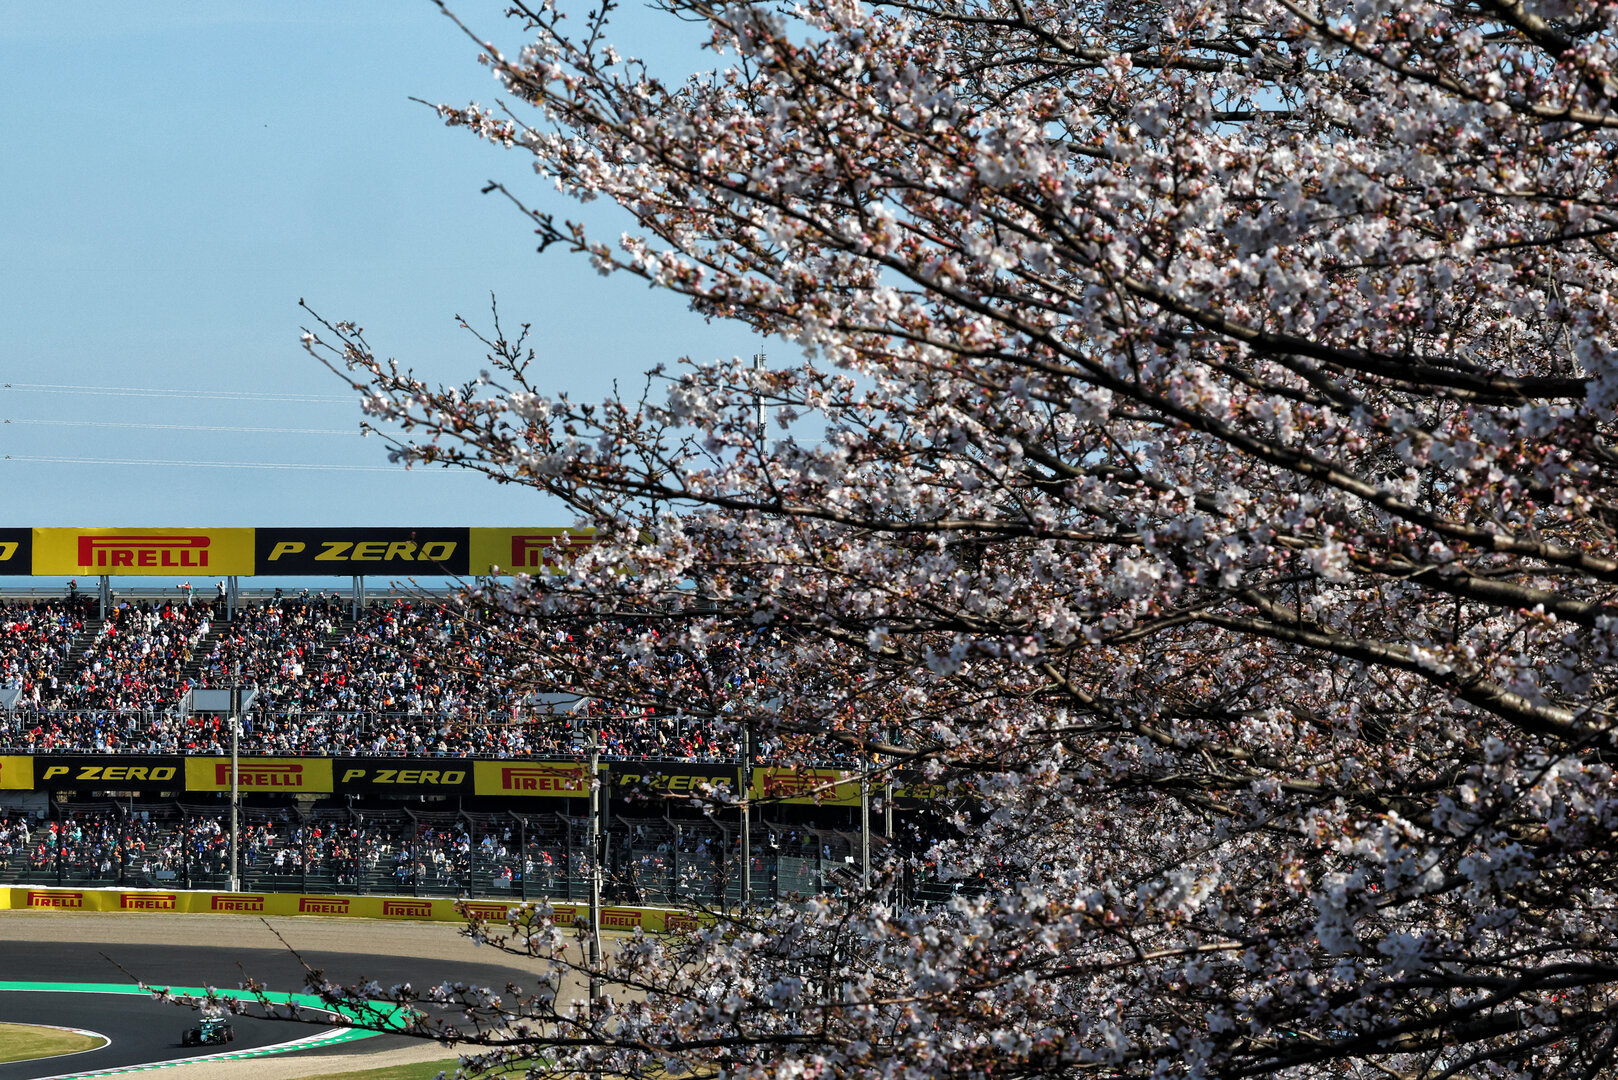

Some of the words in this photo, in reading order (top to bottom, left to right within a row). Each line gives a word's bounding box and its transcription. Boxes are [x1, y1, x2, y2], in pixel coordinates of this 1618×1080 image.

[77, 535, 211, 567] PIRELLI
[267, 541, 306, 561] P
[314, 541, 458, 561] ZERO
[42, 765, 70, 780] P
[75, 766, 177, 781] ZERO
[341, 769, 366, 783] P
[372, 769, 466, 785] ZERO
[27, 891, 83, 908] PIRELLI
[120, 894, 177, 910] PIRELLI
[211, 895, 265, 911] PIRELLI
[299, 897, 350, 914] PIRELLI
[383, 900, 432, 917] PIRELLI
[600, 909, 642, 927] PIRELLI
